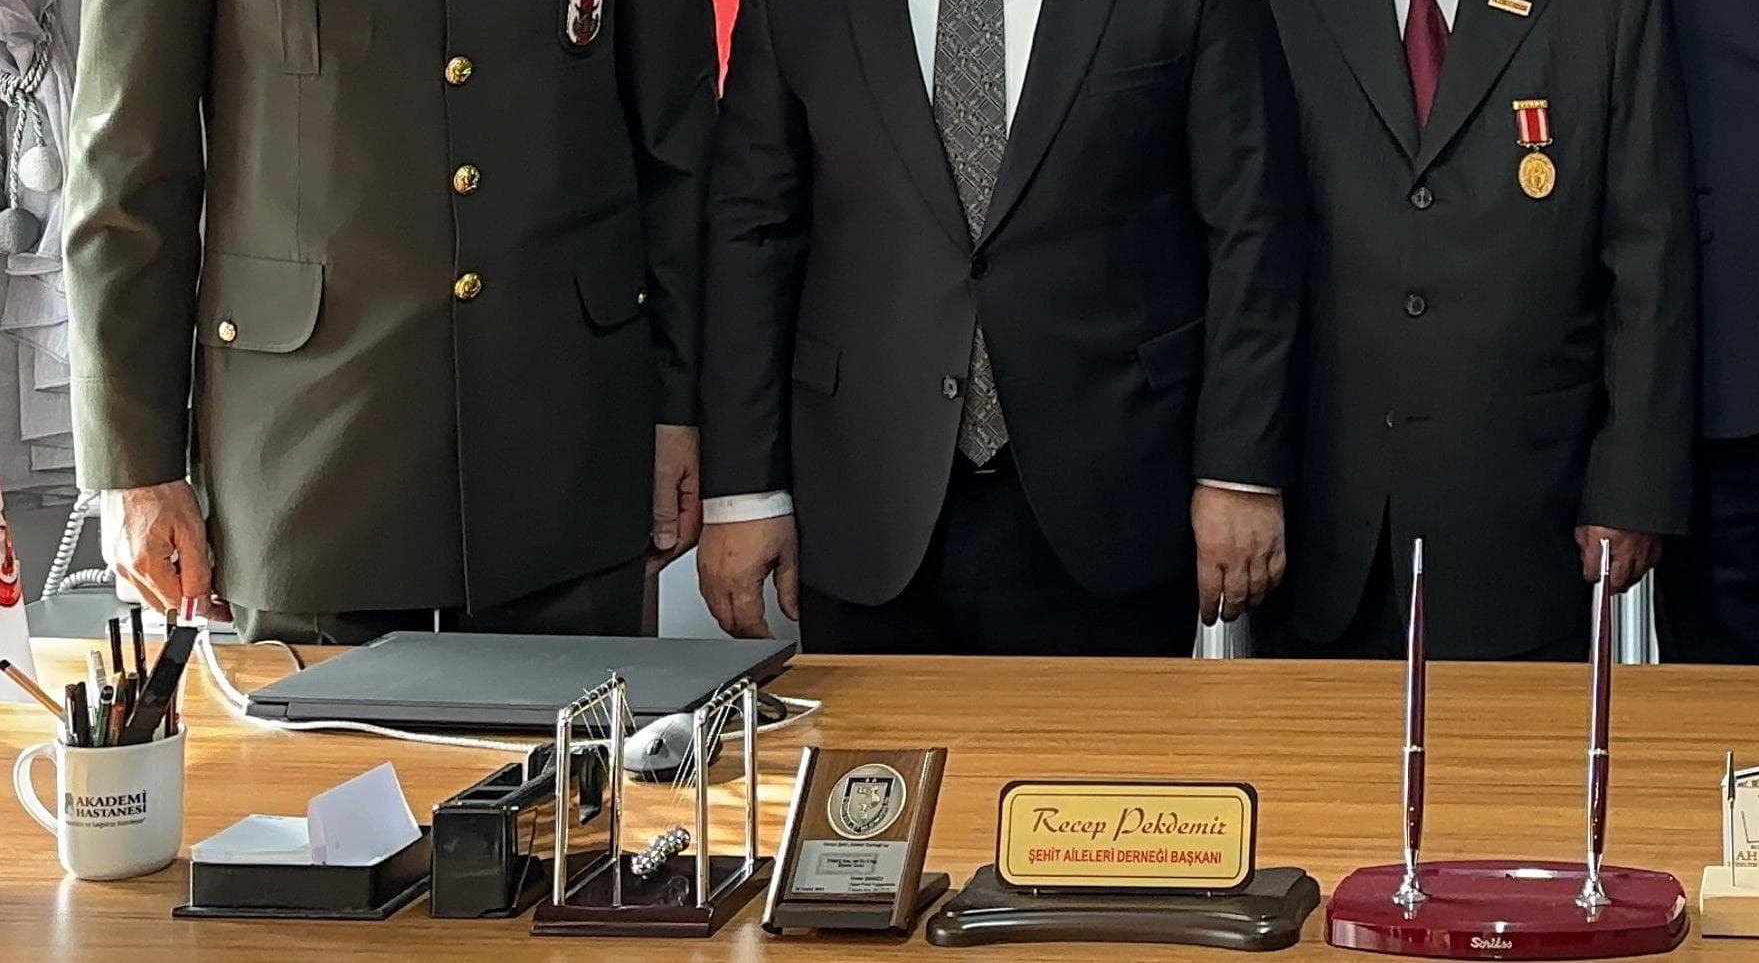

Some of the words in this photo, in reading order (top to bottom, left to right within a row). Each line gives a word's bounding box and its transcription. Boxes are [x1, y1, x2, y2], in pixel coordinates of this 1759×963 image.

[76, 789, 147, 807] AKADEMİ
[1033, 807, 1106, 839] Recep
[1028, 847, 1061, 864] ŞEHİT
[1063, 847, 1115, 863] AİLELERİ
[1117, 848, 1169, 864] DERNEĞİ
[1171, 850, 1222, 866] BAŞKANI
